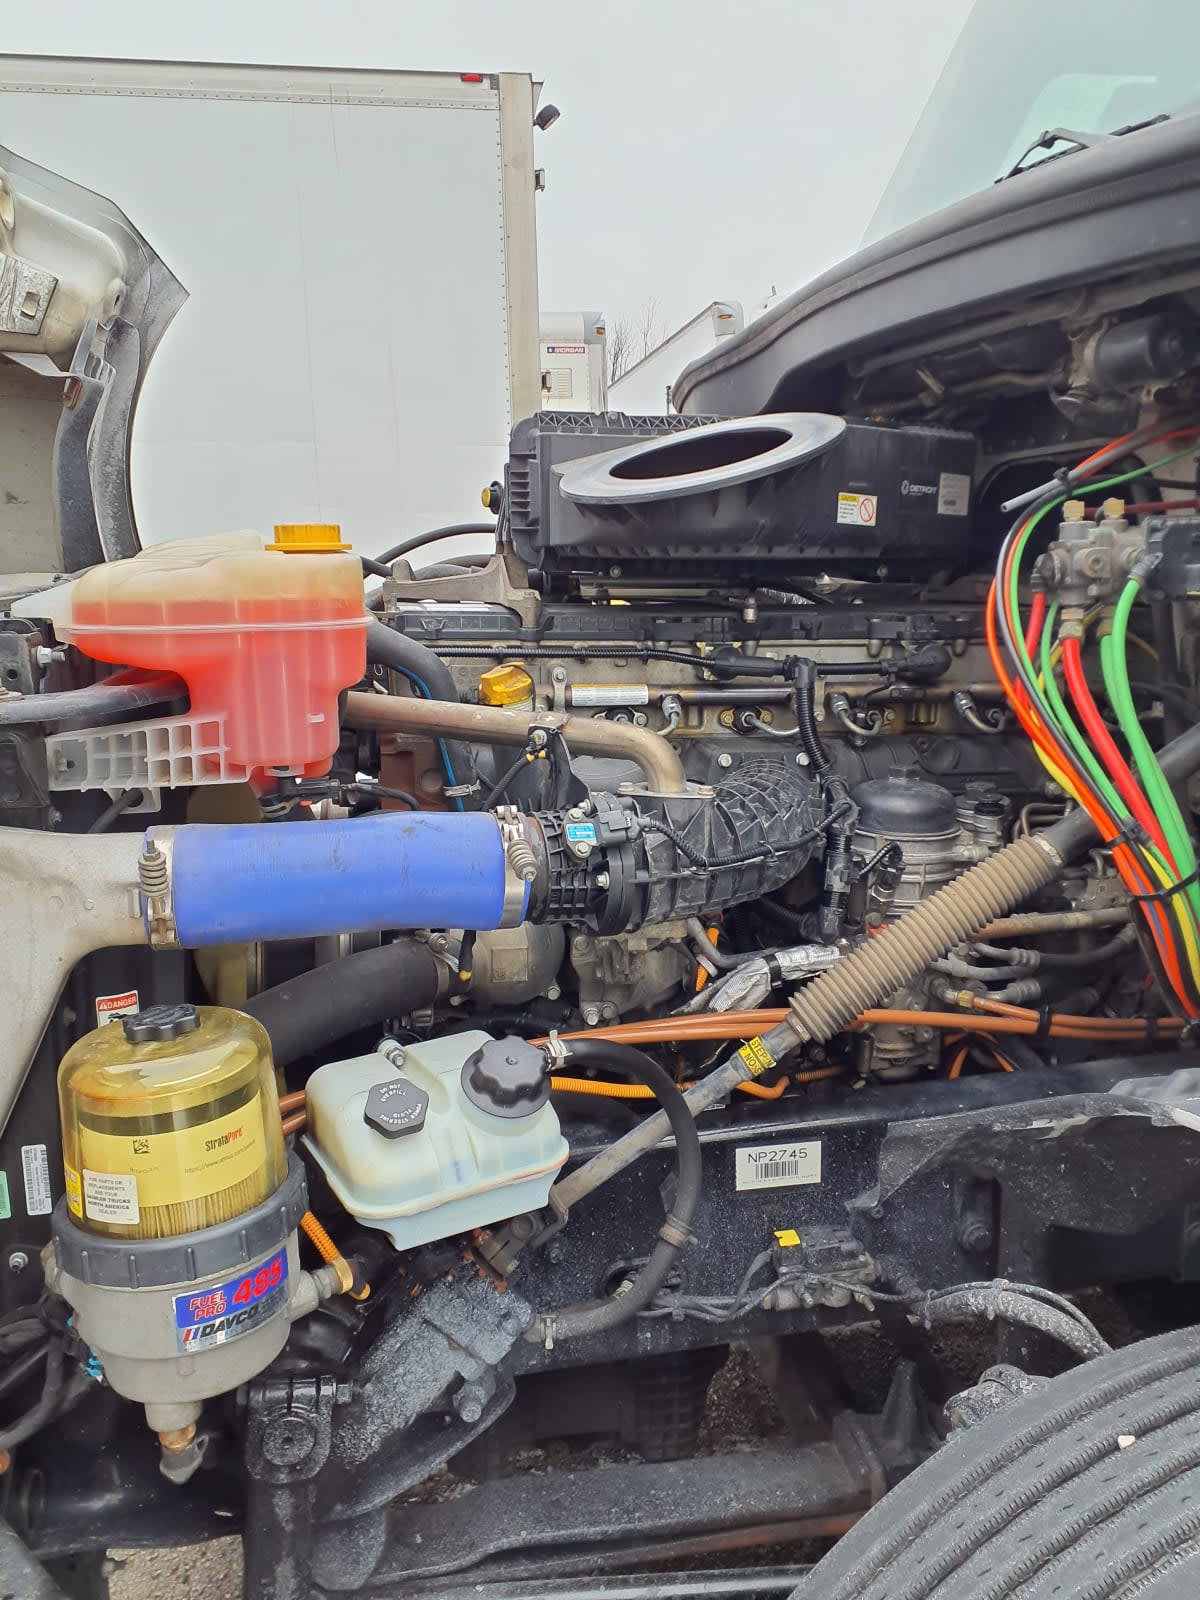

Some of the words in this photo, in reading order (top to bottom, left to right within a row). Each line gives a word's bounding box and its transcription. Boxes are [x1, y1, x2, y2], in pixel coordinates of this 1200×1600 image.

[909, 484, 937, 495] DETROIT
[106, 995, 137, 1009] DANGER
[751, 1039, 768, 1059] STEP
[747, 1147, 809, 1164] NP2745
[232, 1257, 283, 1305] 485
[189, 1290, 227, 1311] FUEL
[194, 1302, 227, 1321] PRO
[200, 1303, 260, 1339] DAYCO
